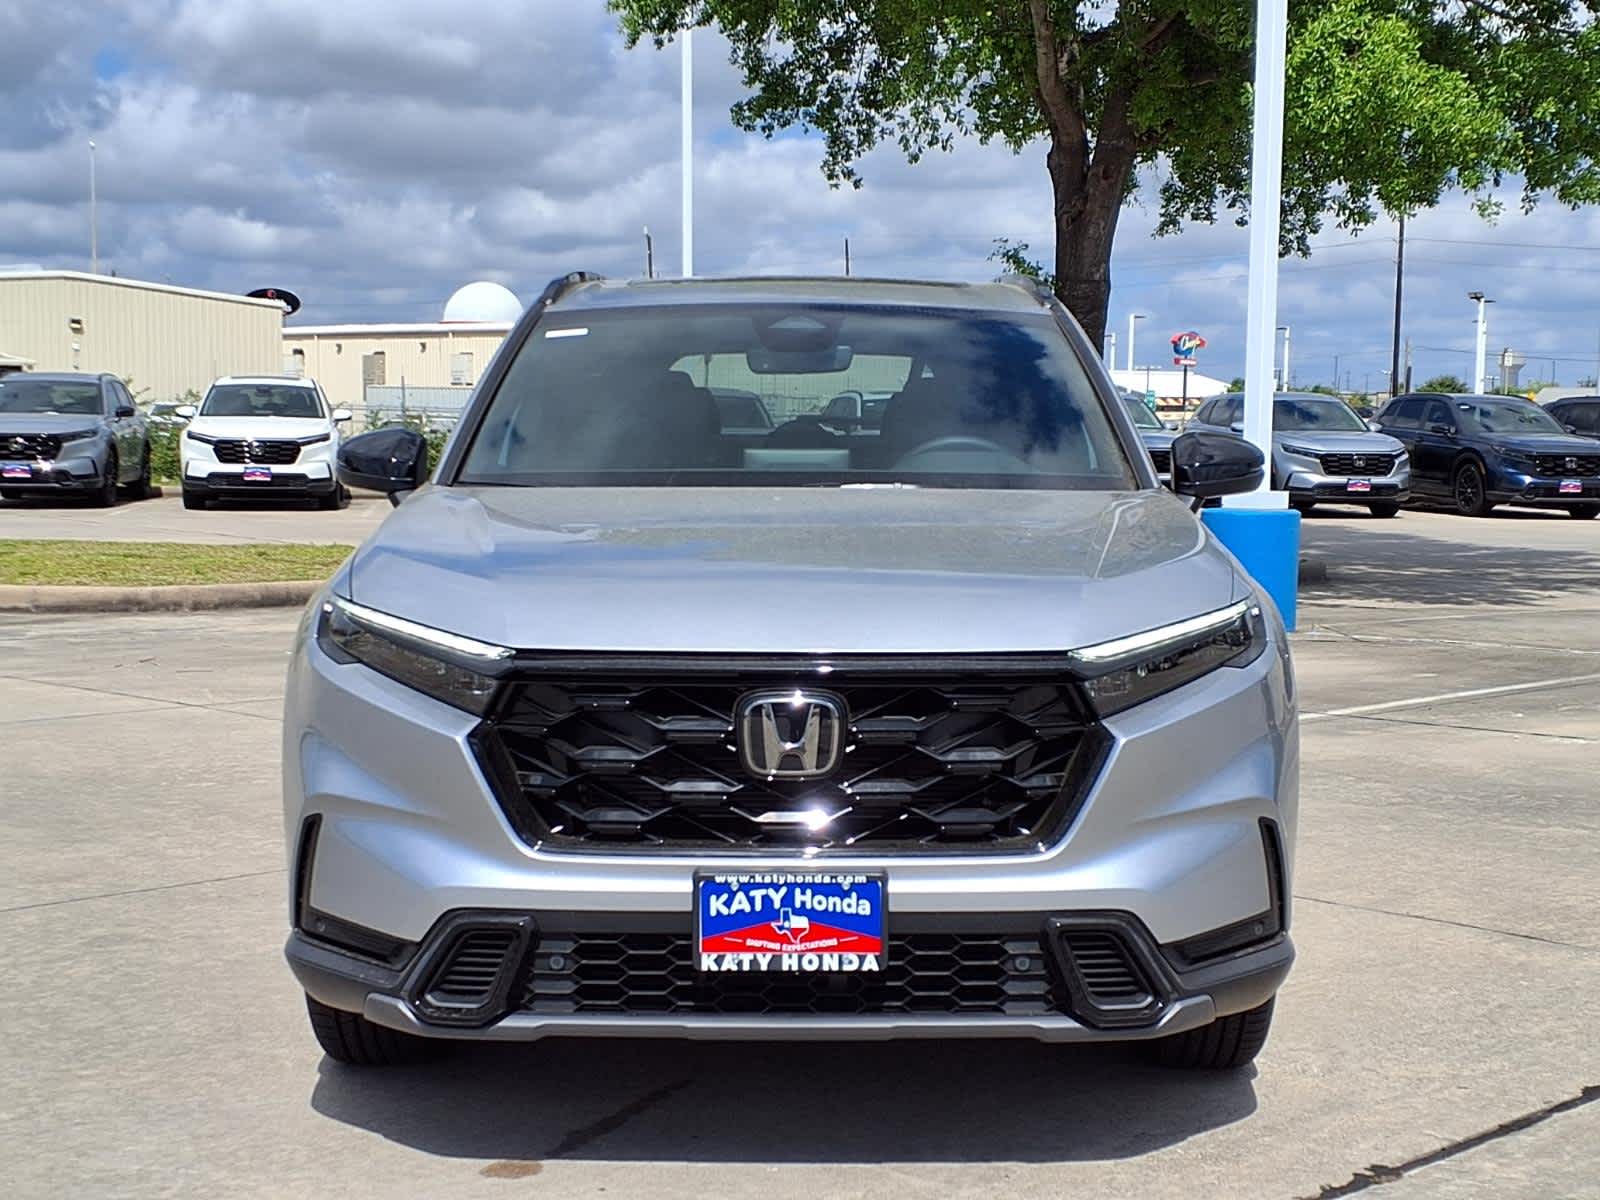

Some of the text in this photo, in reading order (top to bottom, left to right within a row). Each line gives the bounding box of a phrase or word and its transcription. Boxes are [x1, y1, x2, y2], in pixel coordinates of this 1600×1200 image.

[714, 873, 867, 884] www.katyhonda.com
[709, 886, 872, 917] KATY Honda
[701, 953, 880, 972] KATY HONDA
